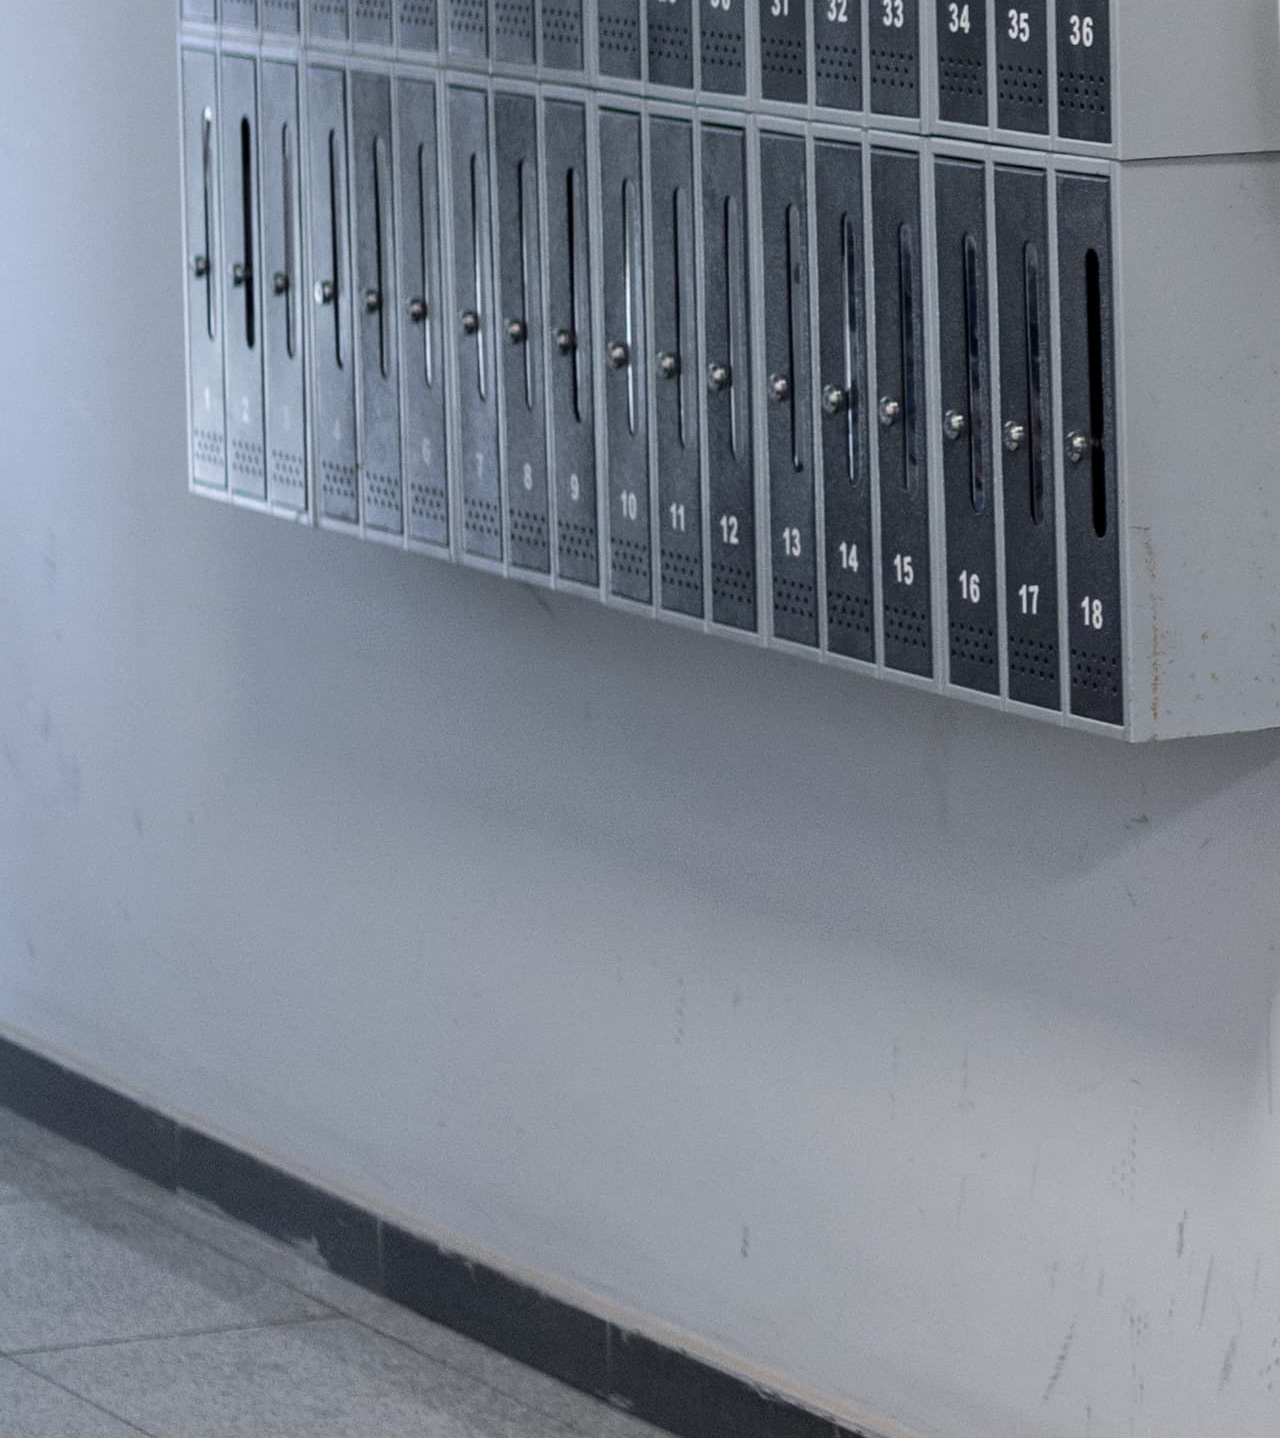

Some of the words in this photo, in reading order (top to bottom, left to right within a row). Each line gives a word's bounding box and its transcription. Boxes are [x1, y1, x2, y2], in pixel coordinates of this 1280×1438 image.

[948, 2, 971, 34] 34
[1008, 8, 1030, 43] 35
[1069, 14, 1094, 48] 36
[523, 462, 533, 491] 8
[569, 473, 580, 501] 9
[620, 489, 638, 521] 10
[669, 502, 685, 531] 11
[719, 515, 739, 545] 12
[782, 527, 802, 557] 13
[839, 541, 859, 573] 14
[893, 553, 914, 586] 15
[959, 569, 981, 604] 16
[1018, 584, 1040, 615] 17
[1080, 595, 1104, 630] 18
